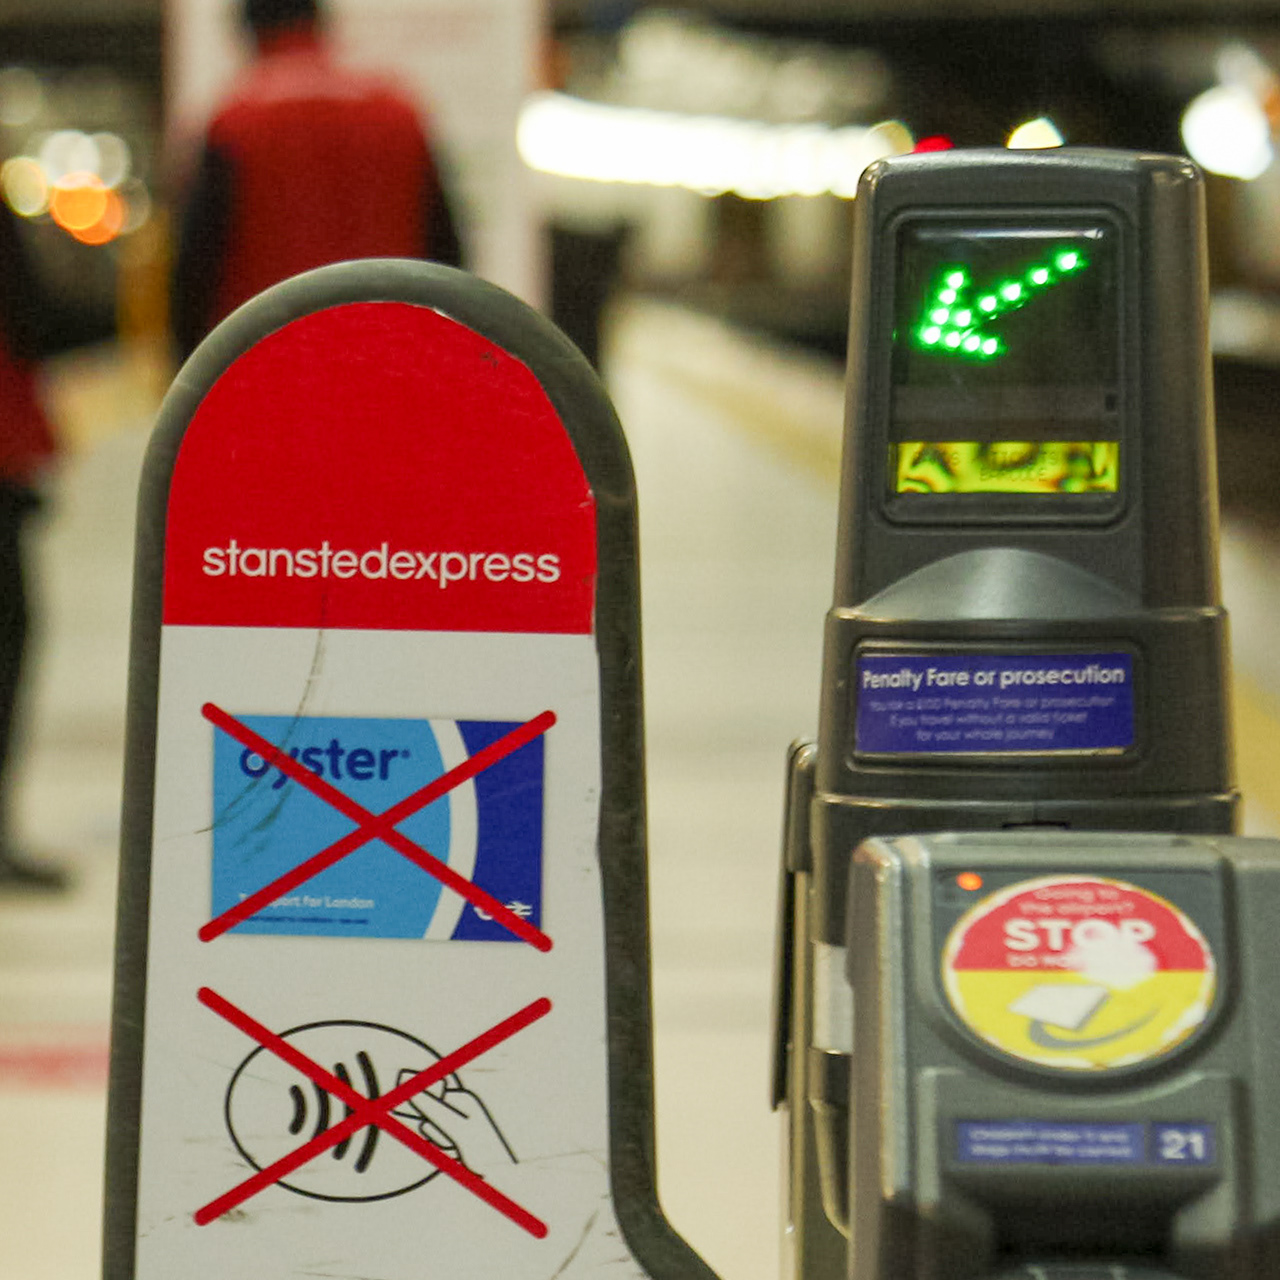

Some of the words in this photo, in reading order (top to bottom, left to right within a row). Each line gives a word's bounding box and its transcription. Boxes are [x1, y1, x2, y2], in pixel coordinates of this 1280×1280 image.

[202, 539, 561, 590] stanstedexpress
[862, 669, 924, 692] Penalty
[926, 668, 970, 687] Fare
[973, 671, 995, 687] or
[999, 665, 1125, 689] prosecution
[1005, 919, 1156, 952] STOP
[1161, 1129, 1205, 1160] 21
